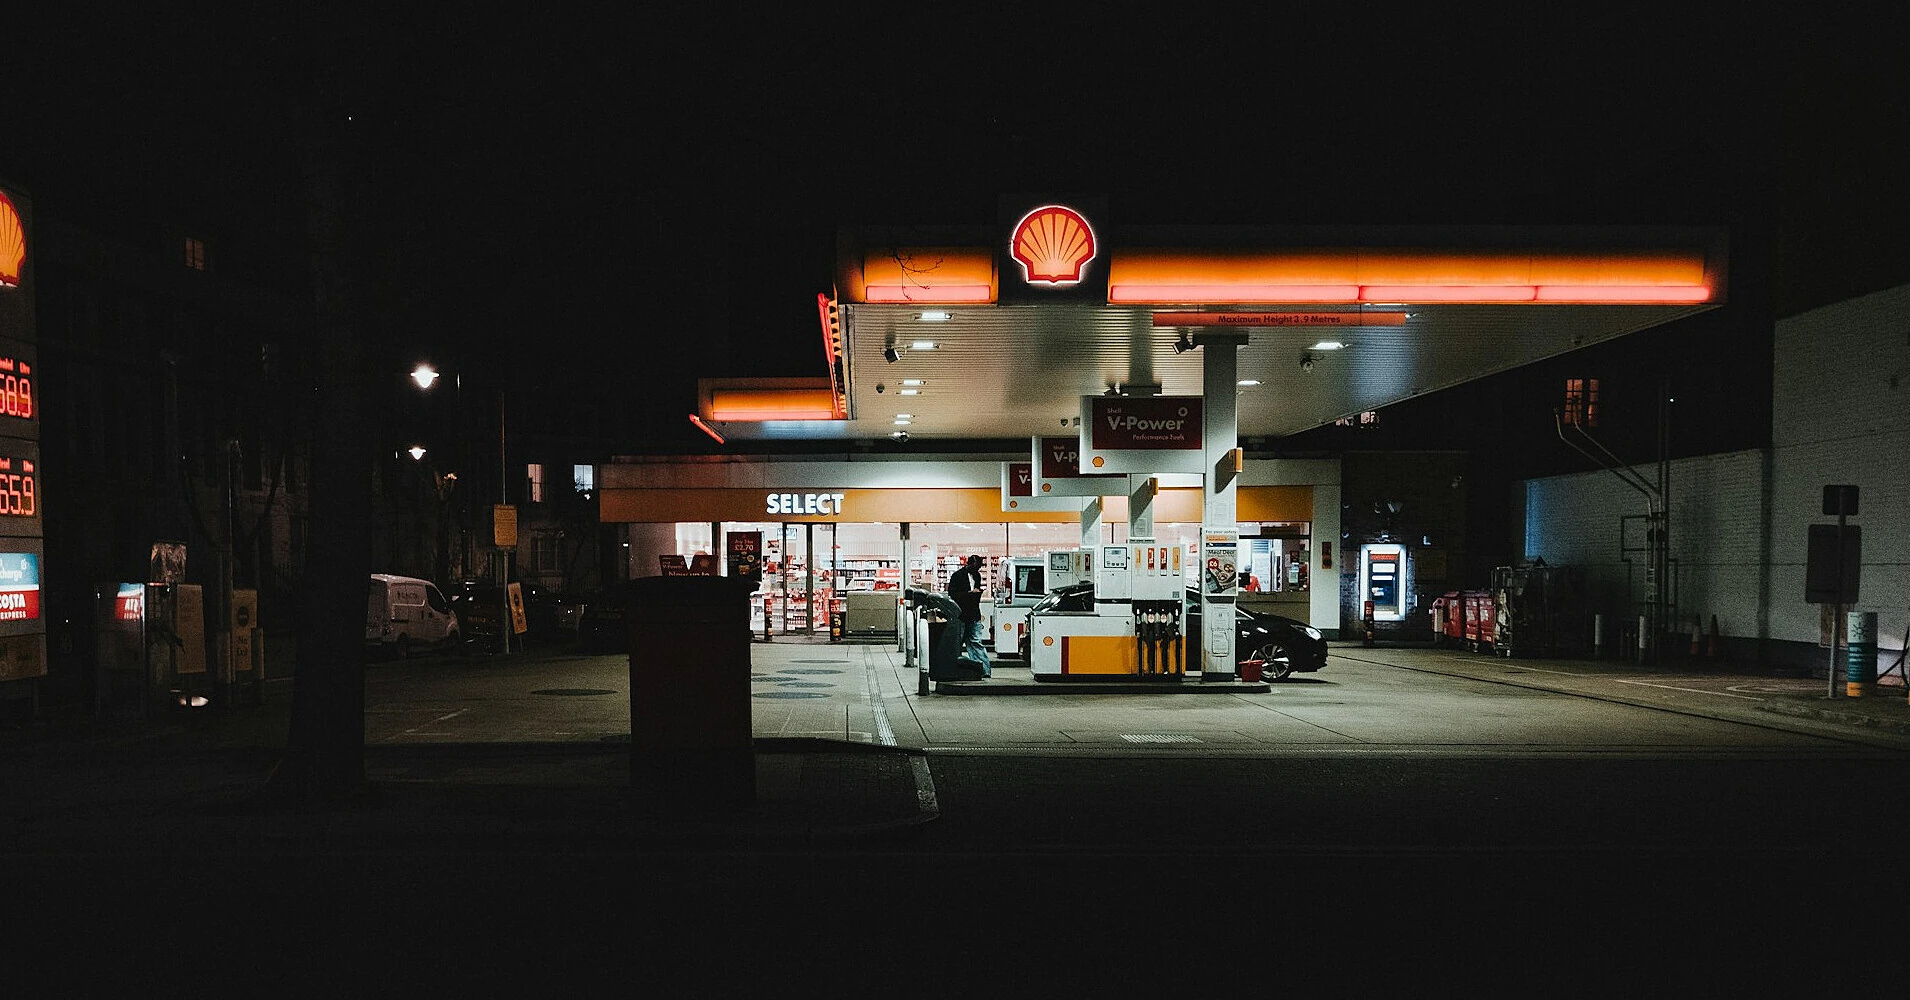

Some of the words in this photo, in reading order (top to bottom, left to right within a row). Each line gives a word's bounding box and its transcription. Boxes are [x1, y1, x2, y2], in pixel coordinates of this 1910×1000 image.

[1219, 315, 1261, 323] Maximum
[1263, 315, 1292, 324] Height
[1310, 315, 1341, 323] Metres
[1107, 416, 1185, 431] V-Power
[766, 493, 845, 514] SELECT
[0, 594, 26, 611] OSTA
